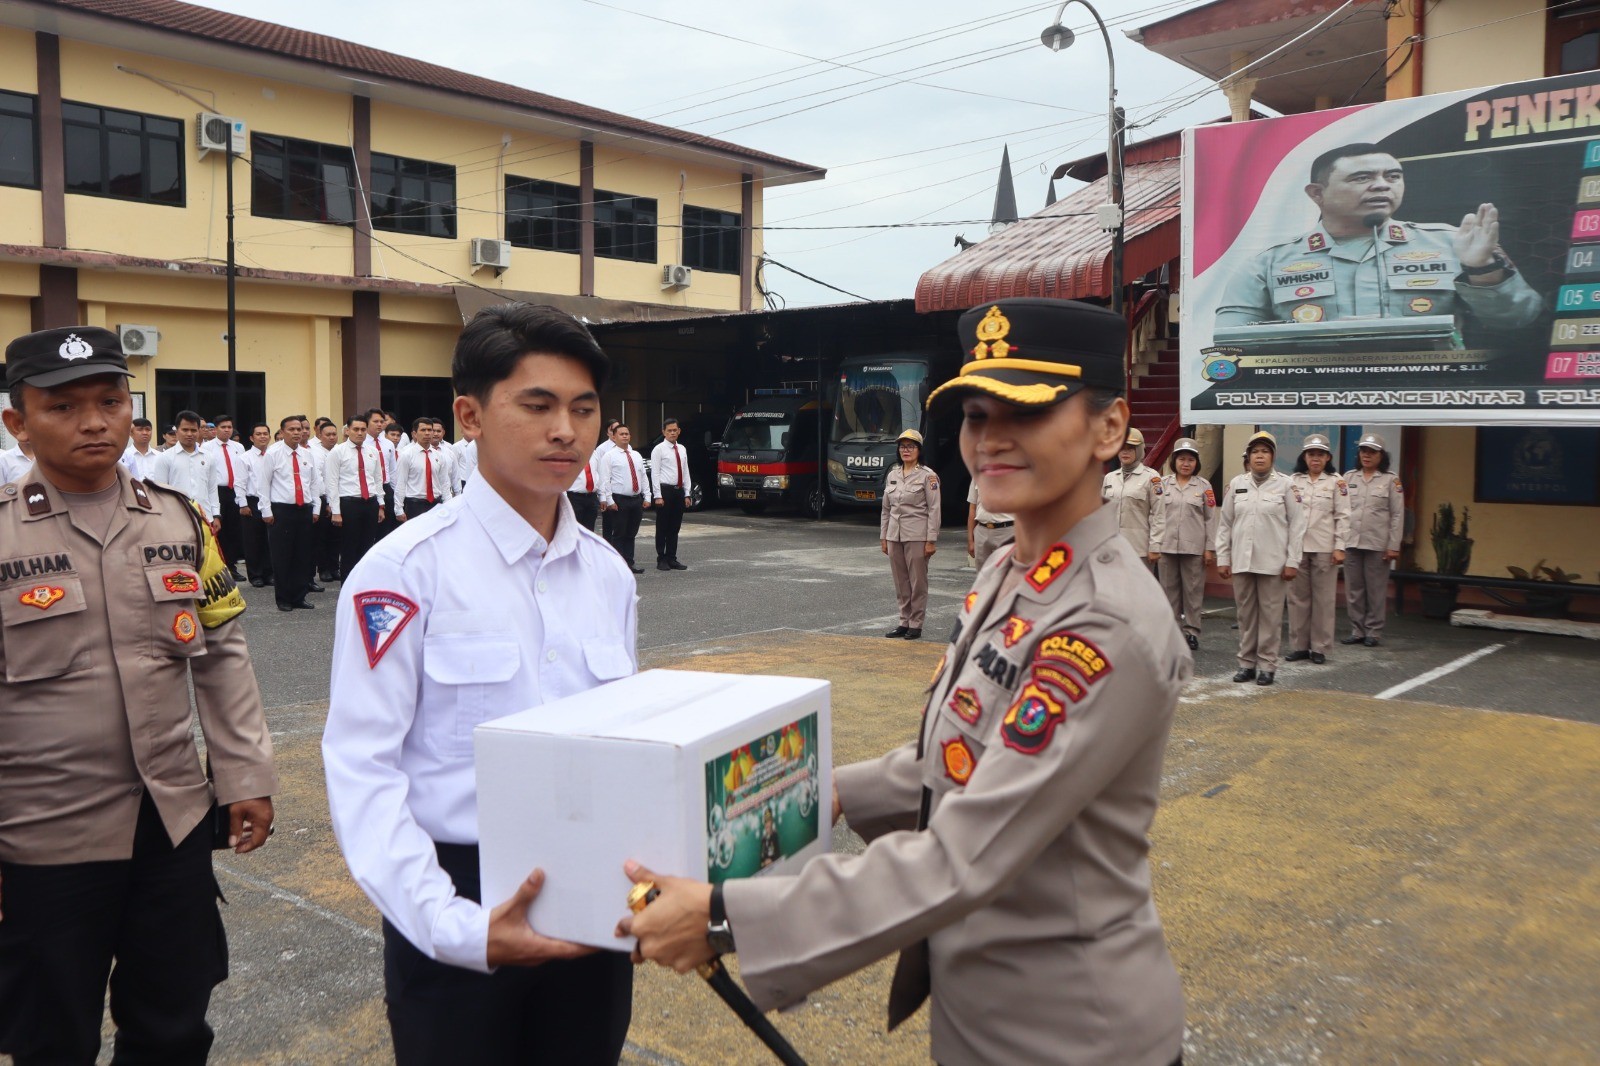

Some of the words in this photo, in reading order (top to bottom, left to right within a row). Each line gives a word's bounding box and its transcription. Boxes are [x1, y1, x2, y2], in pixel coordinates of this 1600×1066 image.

[1580, 214, 1600, 232] 03
[1393, 263, 1447, 273] POLRI
[1572, 251, 1593, 268] 04
[1277, 271, 1329, 286] WHISNU
[1564, 289, 1584, 306] 05
[1558, 323, 1578, 340] 06
[1290, 356, 1345, 364] KEPOLISIAN
[1392, 353, 1447, 361] SUMATERA
[1451, 352, 1488, 360] UTARA
[1552, 357, 1572, 374] 07
[1365, 365, 1440, 373] HERMAWAN
[1216, 391, 1299, 406] POLRES
[1300, 390, 1525, 406] PEMATANGSIANTAR
[737, 464, 759, 473] POLISI
[847, 456, 884, 466] POLISI
[143, 544, 196, 563] POLRI
[0, 554, 73, 582] JULHAM
[1041, 635, 1106, 672] POLRES
